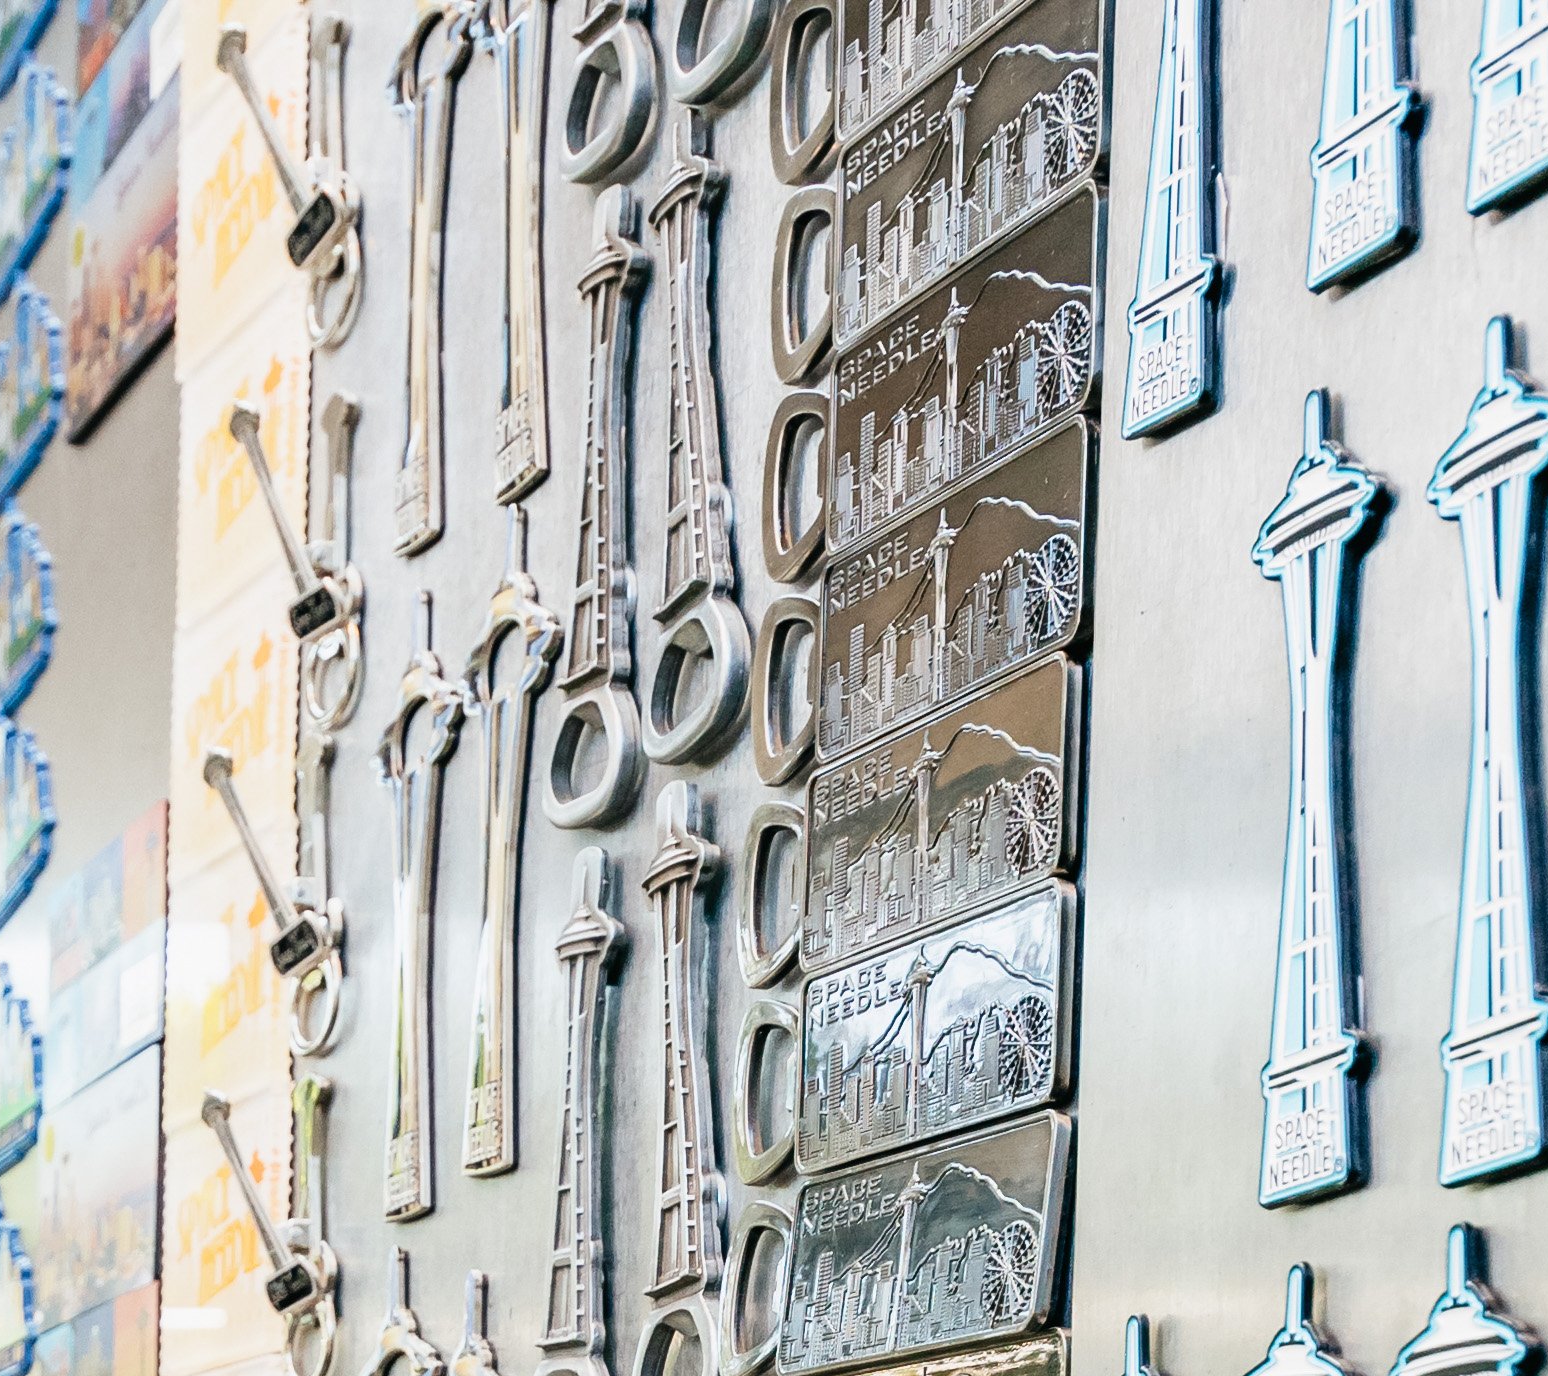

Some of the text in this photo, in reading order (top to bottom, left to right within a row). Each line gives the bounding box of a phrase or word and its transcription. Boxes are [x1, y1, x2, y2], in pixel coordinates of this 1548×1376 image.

[847, 98, 925, 176] SPACE
[1485, 84, 1547, 145] SPACE
[846, 111, 944, 199] NEEDLE
[1325, 169, 1378, 228] SPACE
[839, 327, 942, 407] NEEDLE
[840, 314, 920, 383] SPACE
[1138, 333, 1183, 381] SPACE
[830, 531, 910, 597] SPACE
[830, 545, 929, 616] NEEDLE
[813, 765, 911, 829] NEEDLE
[815, 748, 892, 804] SPACE
[808, 959, 888, 1007] SPACE
[808, 979, 911, 1031] NEEDLE
[1275, 1108, 1326, 1150] SPACE
[1457, 1081, 1515, 1125] SPACE
[803, 1193, 902, 1238] NEEDLE
[805, 1173, 884, 1216] SPACE
